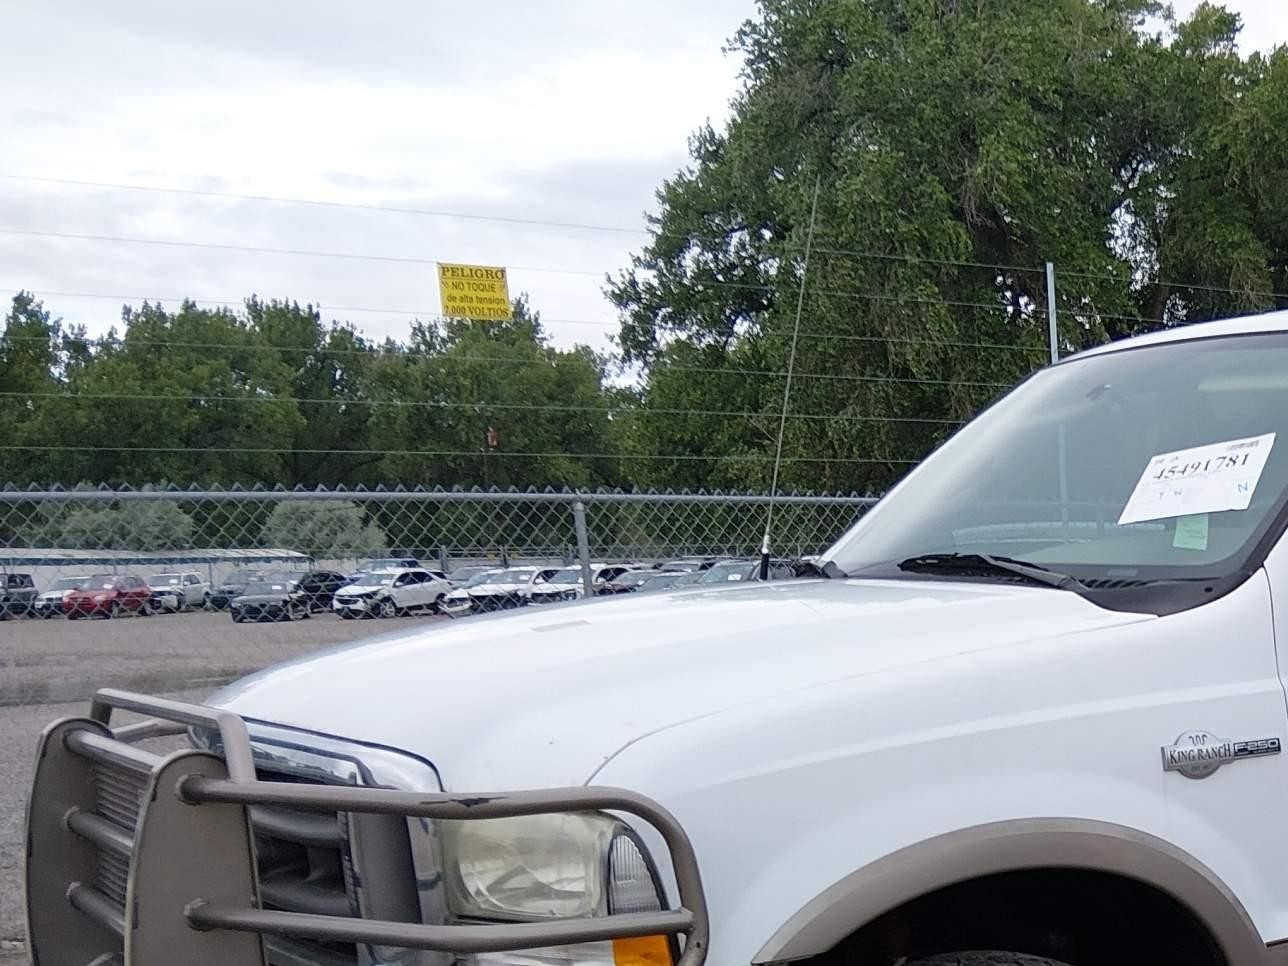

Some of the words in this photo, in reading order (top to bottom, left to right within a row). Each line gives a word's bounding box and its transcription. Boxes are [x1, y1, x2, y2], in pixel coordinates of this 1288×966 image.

[441, 266, 505, 280] PELIGRO
[451, 281, 465, 291] NO
[467, 282, 496, 293] TOQUE
[447, 294, 457, 303] de
[459, 295, 473, 304] alta
[467, 306, 508, 317] VOLTIOS
[1153, 453, 1250, 481] 45491781
[1168, 748, 1196, 765] KING
[1197, 743, 1232, 762] RANCH
